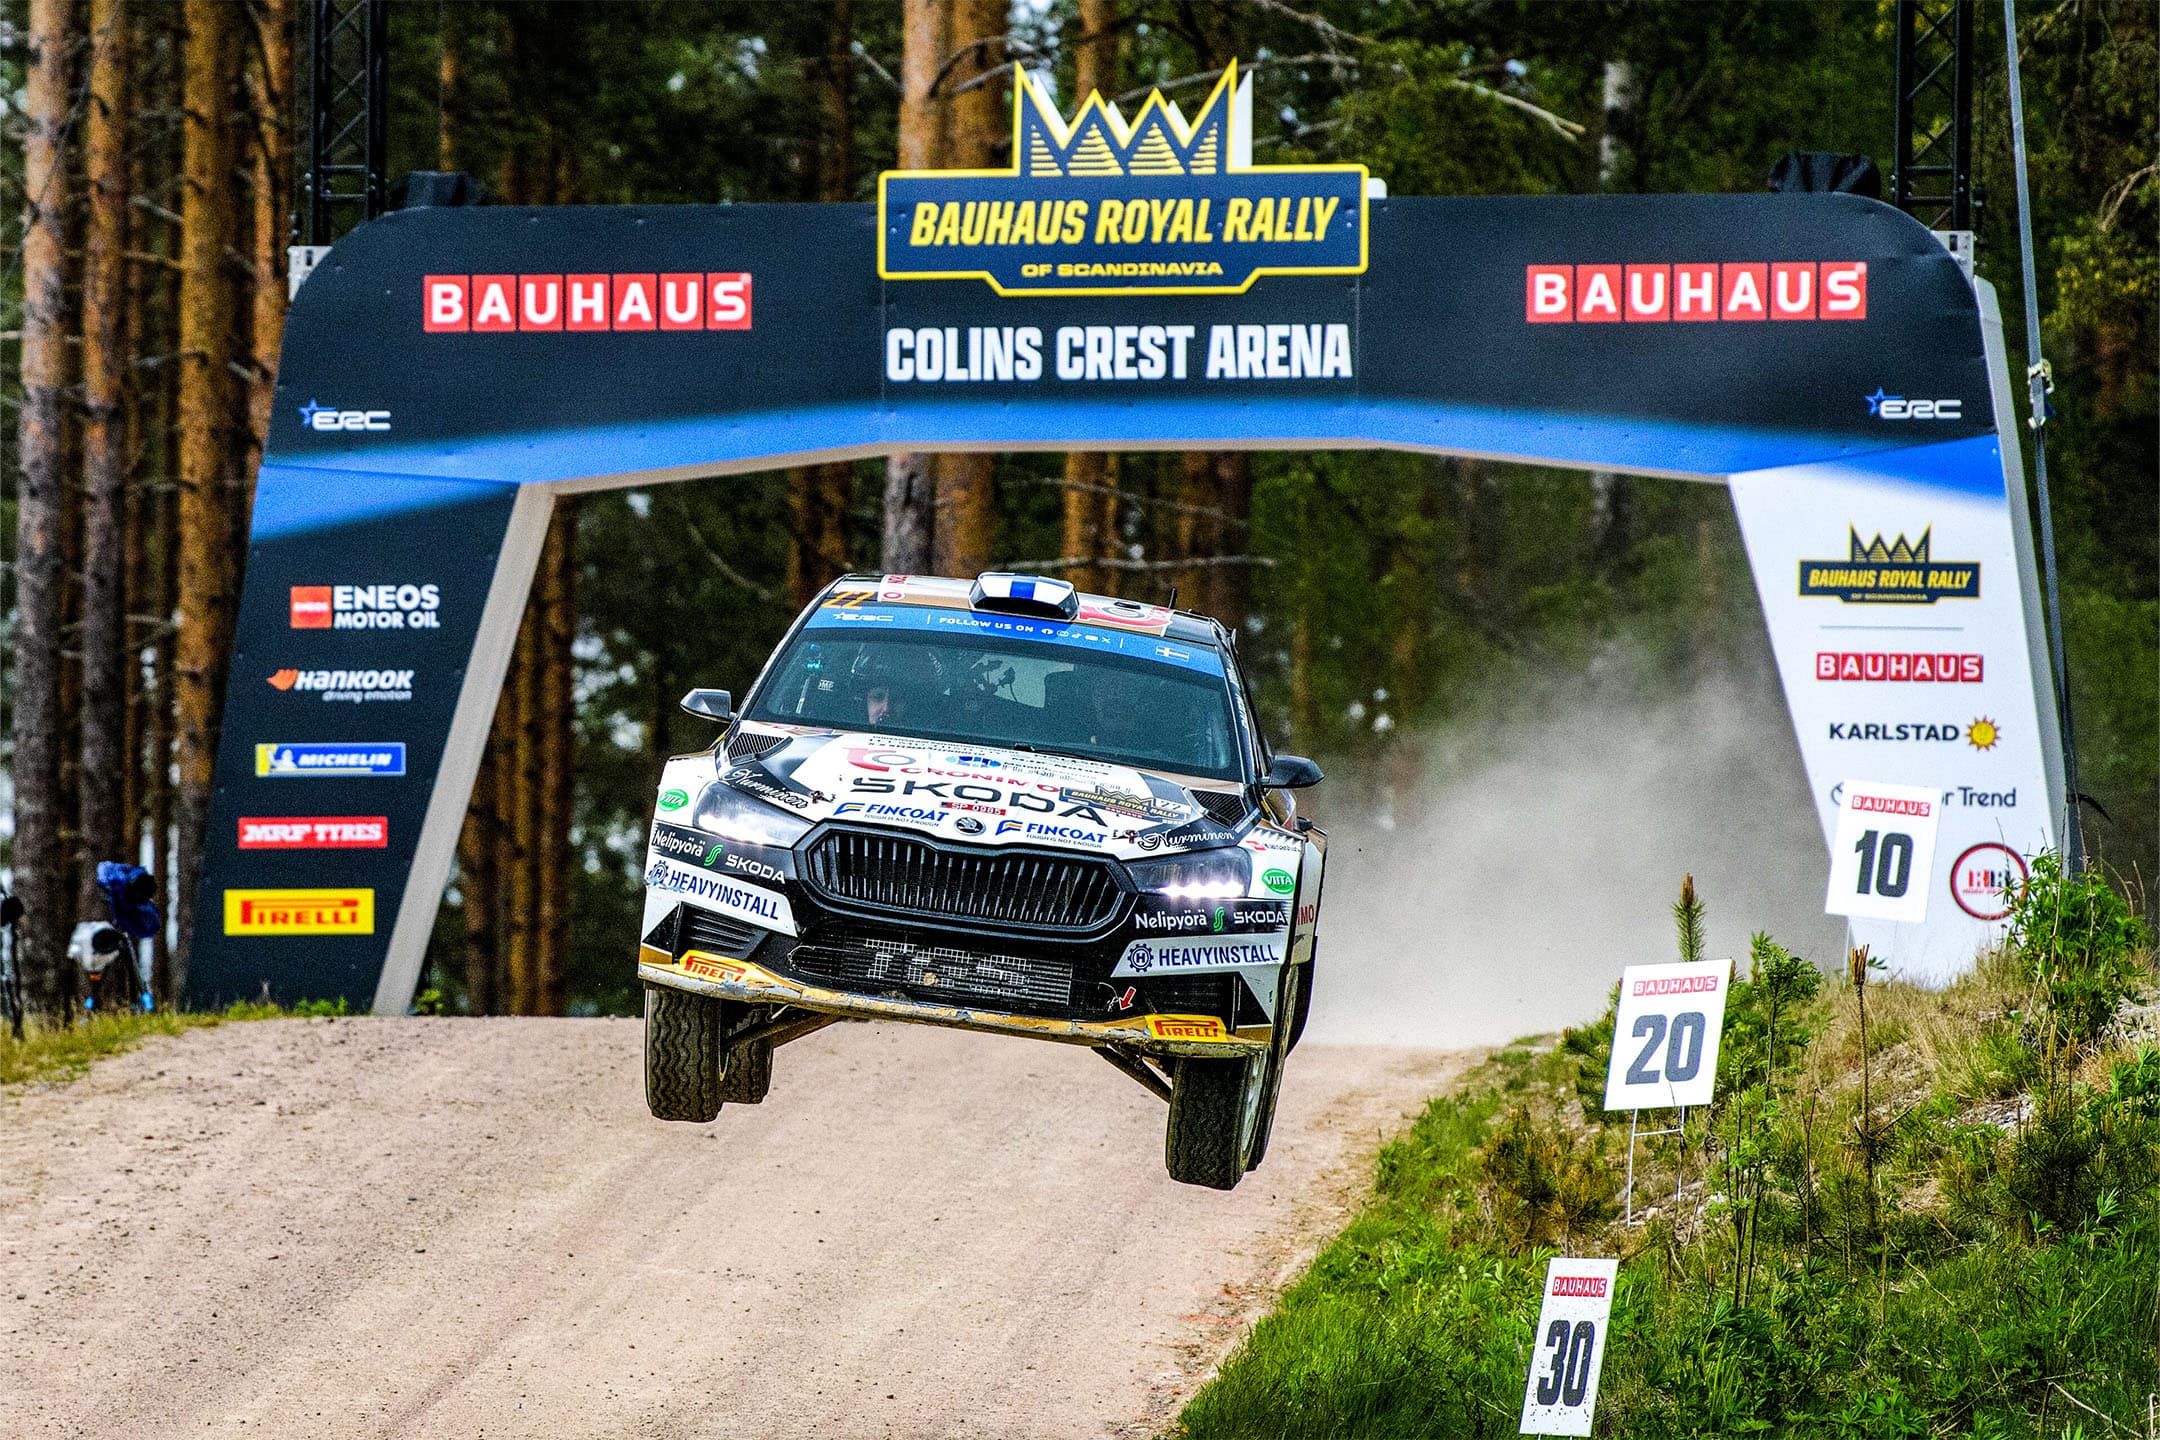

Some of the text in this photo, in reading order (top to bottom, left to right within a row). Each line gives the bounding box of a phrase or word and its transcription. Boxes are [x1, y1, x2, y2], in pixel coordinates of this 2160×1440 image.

[910, 196, 1340, 247] BAUHAUS ROYAL RALLY
[1021, 262, 1223, 278] OF SCANDINAVIA
[428, 277, 749, 327] BAUHAUS
[1531, 267, 1863, 318] BAUHAUS
[885, 323, 1353, 382] COLINS CREST ARENA
[311, 409, 391, 431] ERC
[1878, 399, 1962, 420] ERC
[1809, 569, 1972, 590] BAUHAUS ROYAL RALLY
[333, 585, 440, 611] ENEOS
[333, 611, 441, 629] MOTOR OIL
[939, 617, 1034, 633] FOLLOW US ON
[1819, 654, 1982, 680] BAUHAUS
[1829, 723, 1960, 742] KARLSTAD
[297, 753, 392, 767] MICHELIN
[1852, 795, 1931, 816] BAUHAUS
[1958, 786, 2017, 807] Trend
[866, 803, 950, 822] FINCOAT
[313, 823, 383, 842] TYRES
[652, 829, 706, 858] Nelipyörä
[1026, 823, 1108, 843] FINCOAT
[1137, 828, 1235, 851] Nurminen
[1854, 829, 1914, 898] 10
[668, 869, 779, 921] HEAVYINSTALL
[239, 898, 359, 926] PIRELLI
[1134, 907, 1207, 930] Nelipyörä
[1158, 944, 1280, 968] HEAVYINSTALL
[1633, 975, 1719, 998] BAUHAUS
[1154, 1019, 1219, 1038] PIRELLI
[1624, 1011, 1707, 1086] 20
[1552, 1276, 1608, 1298] BAUHAUS
[1537, 1319, 1595, 1408] 30
